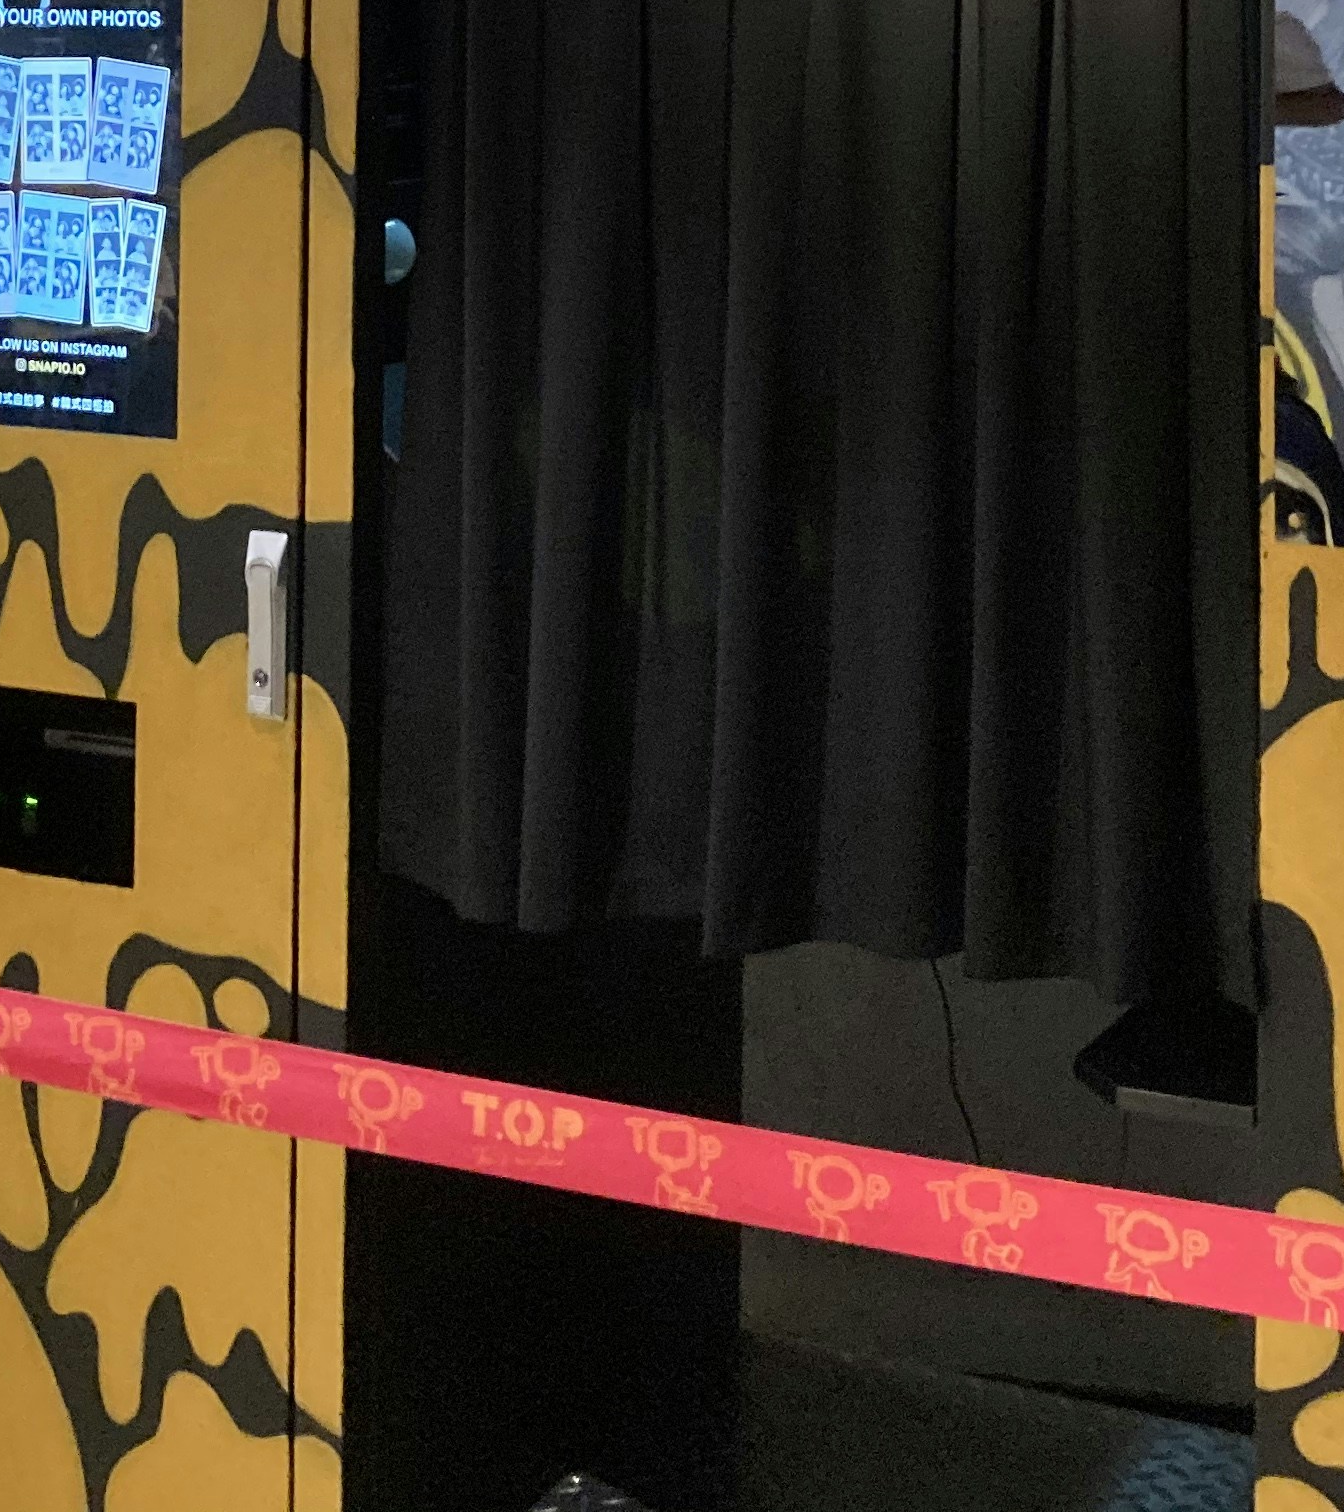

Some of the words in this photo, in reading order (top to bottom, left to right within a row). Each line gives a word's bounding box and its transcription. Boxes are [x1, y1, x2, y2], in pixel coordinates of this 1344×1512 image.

[47, 9, 87, 26] OWN
[91, 10, 161, 28] PHOTOS
[23, 339, 40, 352] US
[41, 341, 59, 355] ON
[60, 342, 127, 358] INSTAGRAM
[28, 359, 86, 376] SNAPIO.IO
[64, 1011, 145, 1063] TOP
[190, 1037, 281, 1090] TOP
[332, 1063, 424, 1123] TOP
[625, 1117, 722, 1171] TOP
[786, 1150, 890, 1212] TOP
[926, 1169, 1039, 1230] TOP
[1096, 1203, 1210, 1269] TOP
